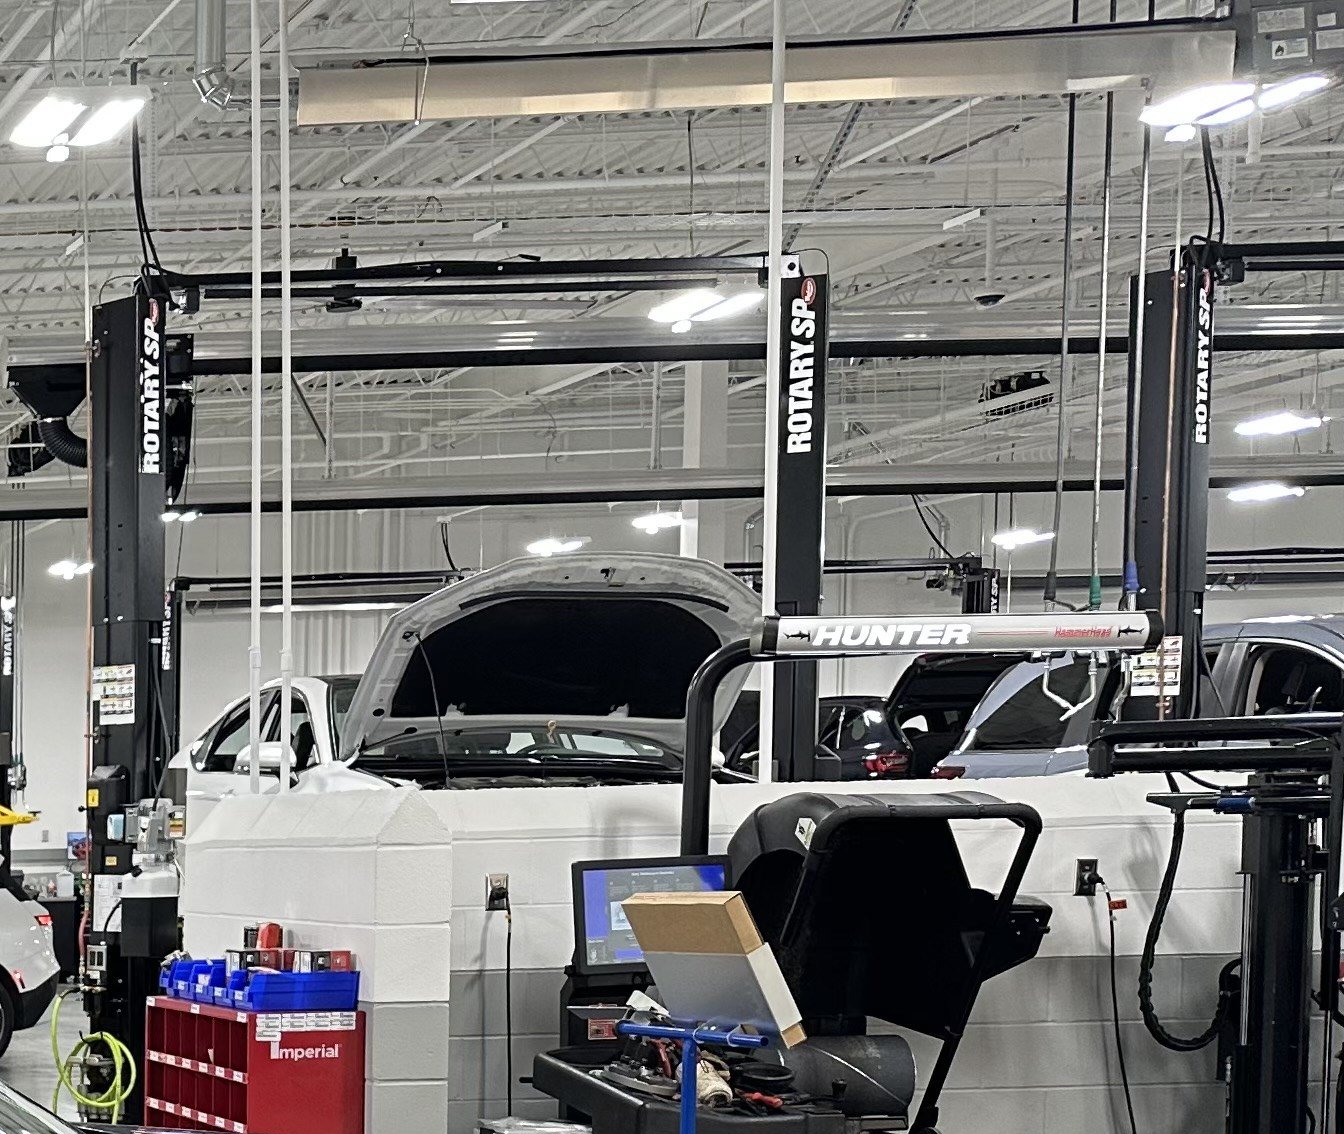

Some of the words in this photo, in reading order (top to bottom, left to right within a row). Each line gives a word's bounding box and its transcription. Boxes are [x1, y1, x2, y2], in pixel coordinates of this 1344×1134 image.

[791, 298, 816, 338] SP
[143, 359, 160, 473] ROTARY
[787, 341, 814, 453] ROTARY
[1195, 330, 1210, 443] ROTARY
[812, 623, 972, 647] HUNTER
[271, 1041, 339, 1061] Imperial
